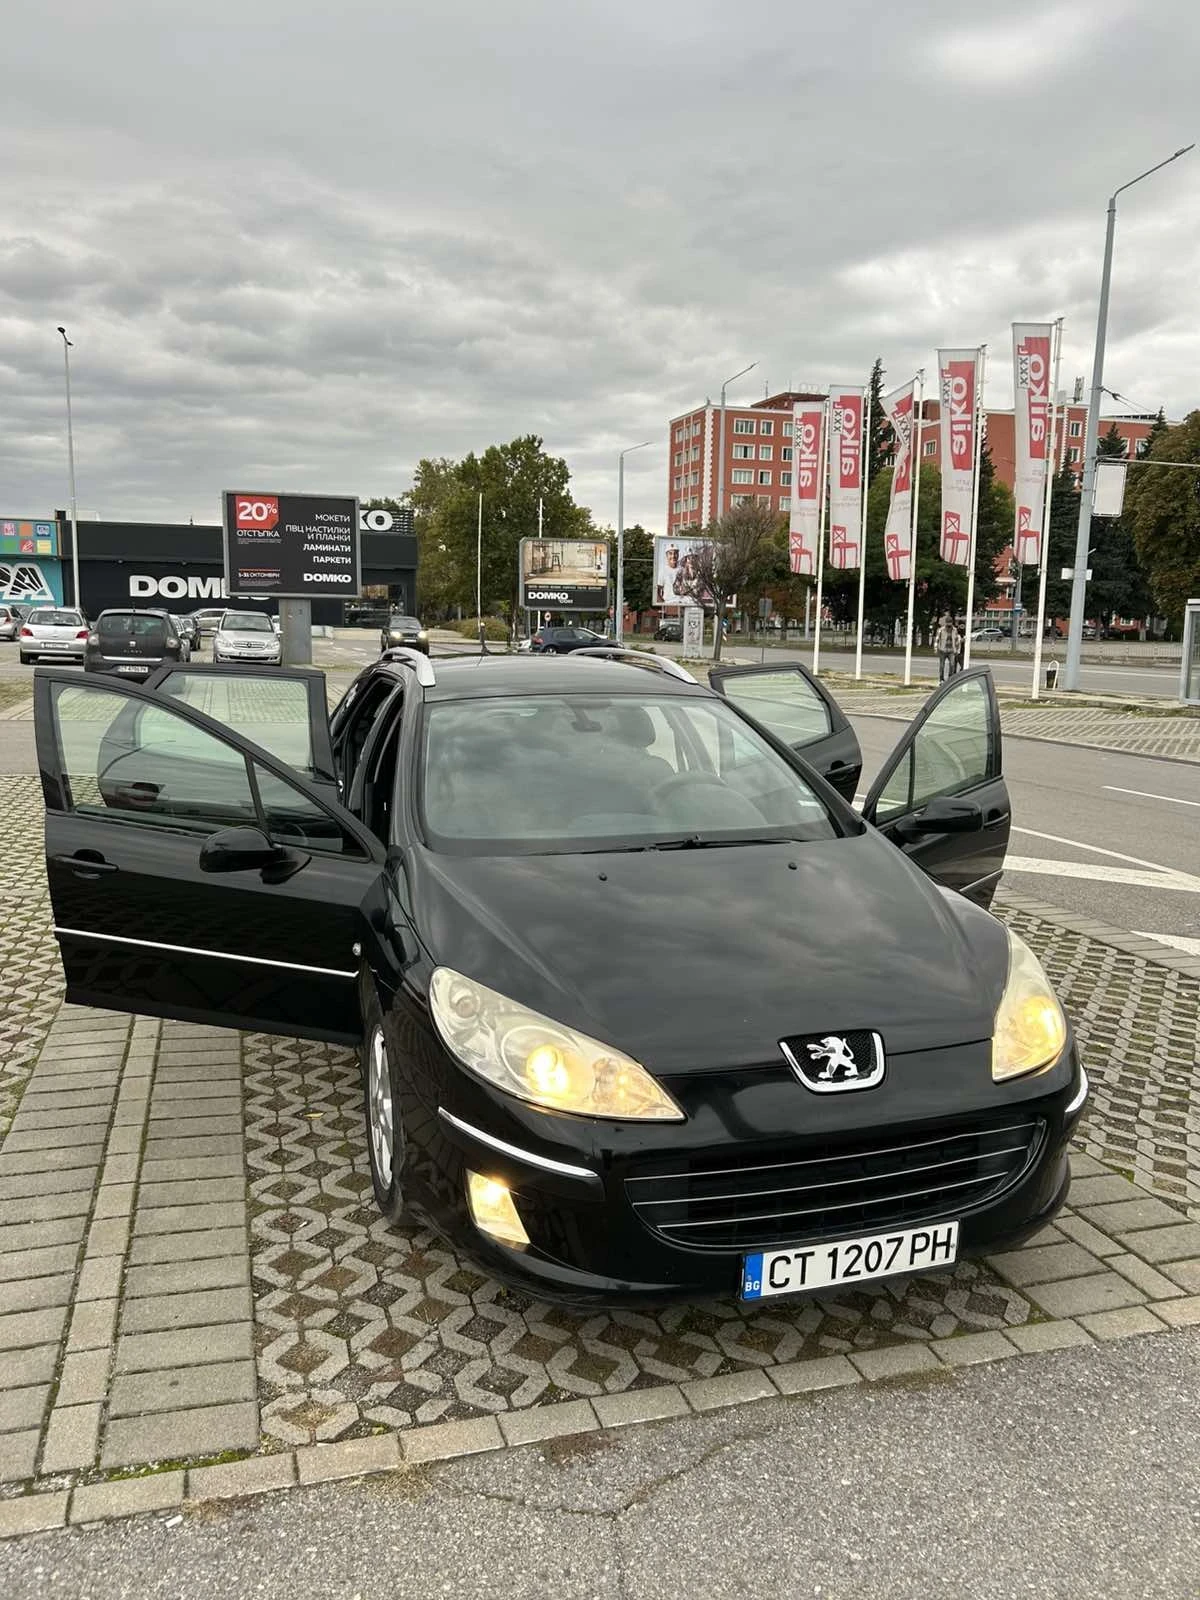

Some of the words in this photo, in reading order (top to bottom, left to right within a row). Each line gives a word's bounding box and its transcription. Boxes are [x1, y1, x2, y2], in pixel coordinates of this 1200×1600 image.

[238, 501, 278, 521] 20%
[315, 513, 351, 522] МОКЕТИ
[236, 529, 280, 538] ОТСТЪПКА
[285, 524, 304, 533] ПВЦ
[305, 525, 351, 534] НАСТИЛКИ
[307, 533, 314, 541] И
[315, 532, 351, 542] ПЛАНКИ
[302, 543, 352, 553] ЛАМИНАТИ
[312, 555, 352, 565] ПАРКЕТИ
[303, 572, 352, 584] DOMKO
[527, 591, 569, 600] DOMKO
[744, 1280, 760, 1292] BG
[769, 1251, 815, 1289] CT
[827, 1236, 904, 1280] 1207
[909, 1227, 953, 1266] PH
